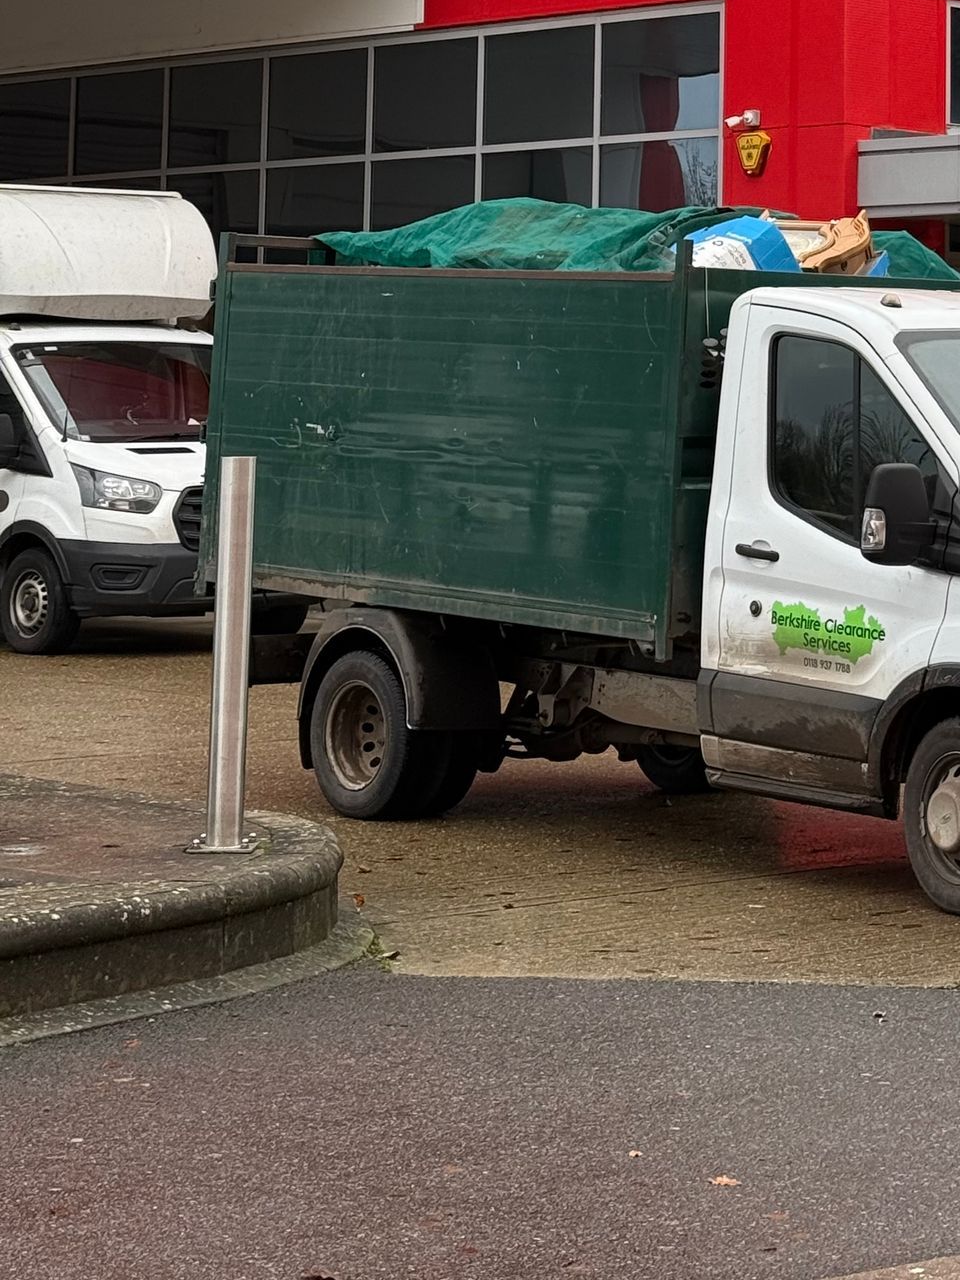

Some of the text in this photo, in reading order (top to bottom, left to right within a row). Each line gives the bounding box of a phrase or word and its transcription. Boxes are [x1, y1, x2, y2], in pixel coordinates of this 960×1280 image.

[771, 610, 886, 642] Berkshire Clearance
[803, 632, 851, 653] Services
[820, 660, 832, 671] 937
[835, 662, 851, 673] 1788
